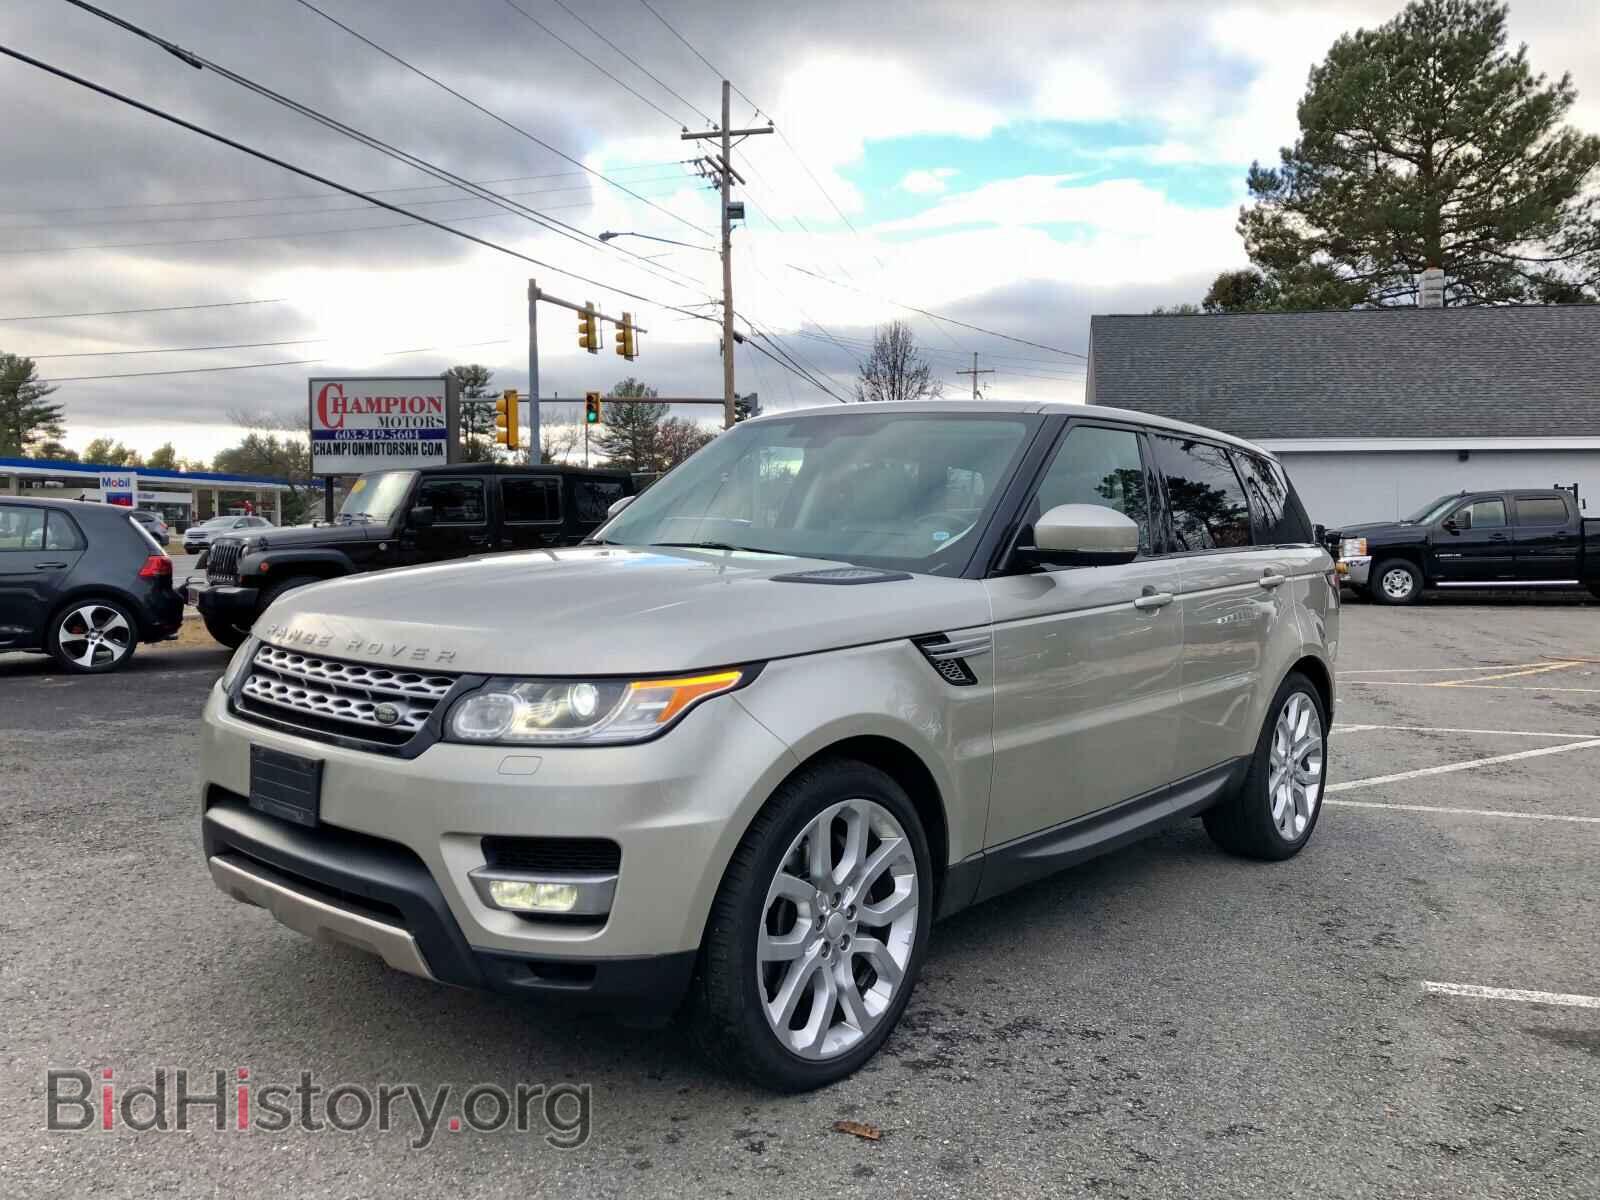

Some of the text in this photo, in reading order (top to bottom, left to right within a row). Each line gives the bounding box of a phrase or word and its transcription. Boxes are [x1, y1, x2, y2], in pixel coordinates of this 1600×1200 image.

[378, 416, 444, 428] MOTORS
[102, 477, 130, 488] Mobil
[345, 640, 457, 663] ROVER
